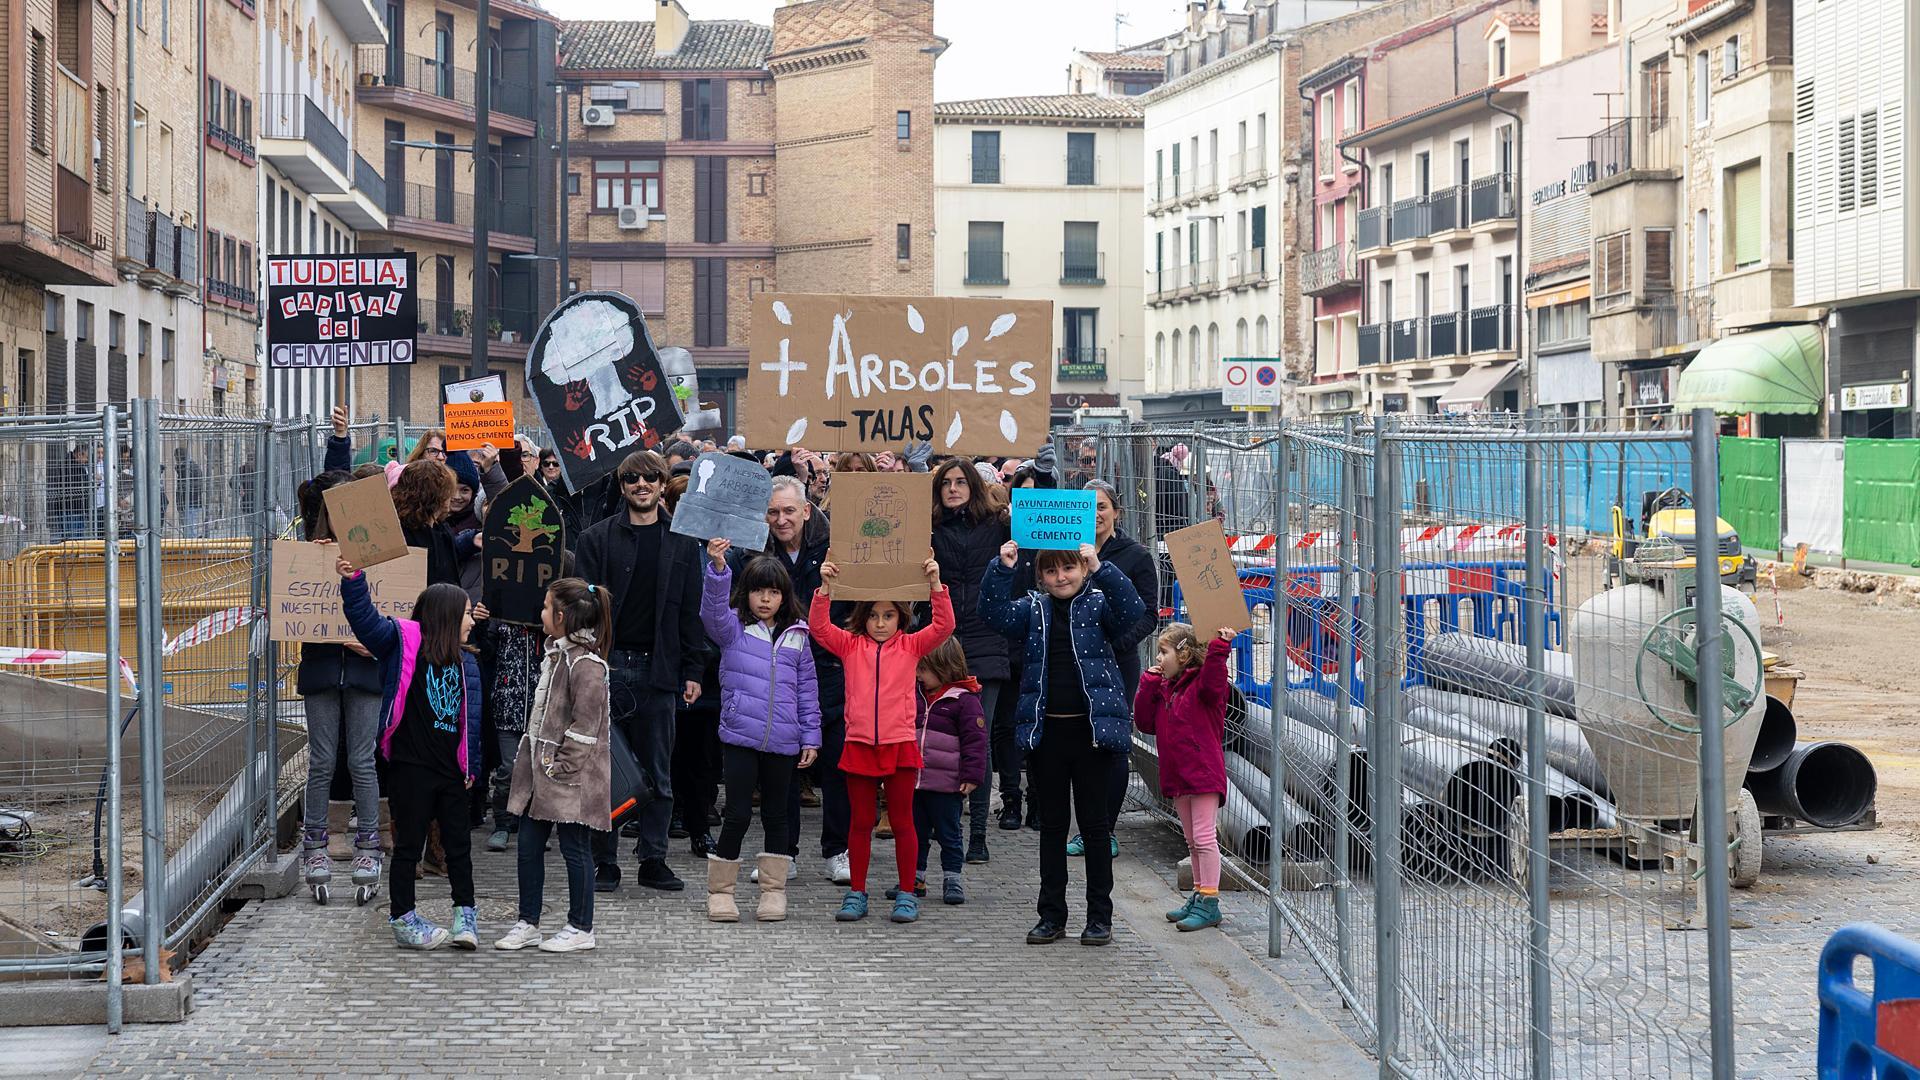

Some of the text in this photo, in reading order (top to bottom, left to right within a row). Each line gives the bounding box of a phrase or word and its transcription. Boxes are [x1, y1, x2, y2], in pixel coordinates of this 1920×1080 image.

[271, 261, 405, 287] TUDELA,
[282, 293, 397, 316] CAPITAL
[319, 319, 358, 336] del
[272, 341, 412, 366] CEMENTO
[445, 408, 507, 417] ¡AYUNTAMIENTO!
[450, 419, 509, 429] MÁS ÁRBOLES
[584, 396, 656, 461] RIP
[851, 404, 934, 442] TALAS
[1015, 500, 1092, 509] ¡AYUNTAMIENTO!
[1036, 513, 1082, 525] ÁRBOLES
[1031, 531, 1082, 541] CEMENTO
[282, 601, 338, 614] NUESTRA
[394, 601, 415, 613] PER
[286, 621, 306, 636] NO
[313, 623, 328, 635] EN
